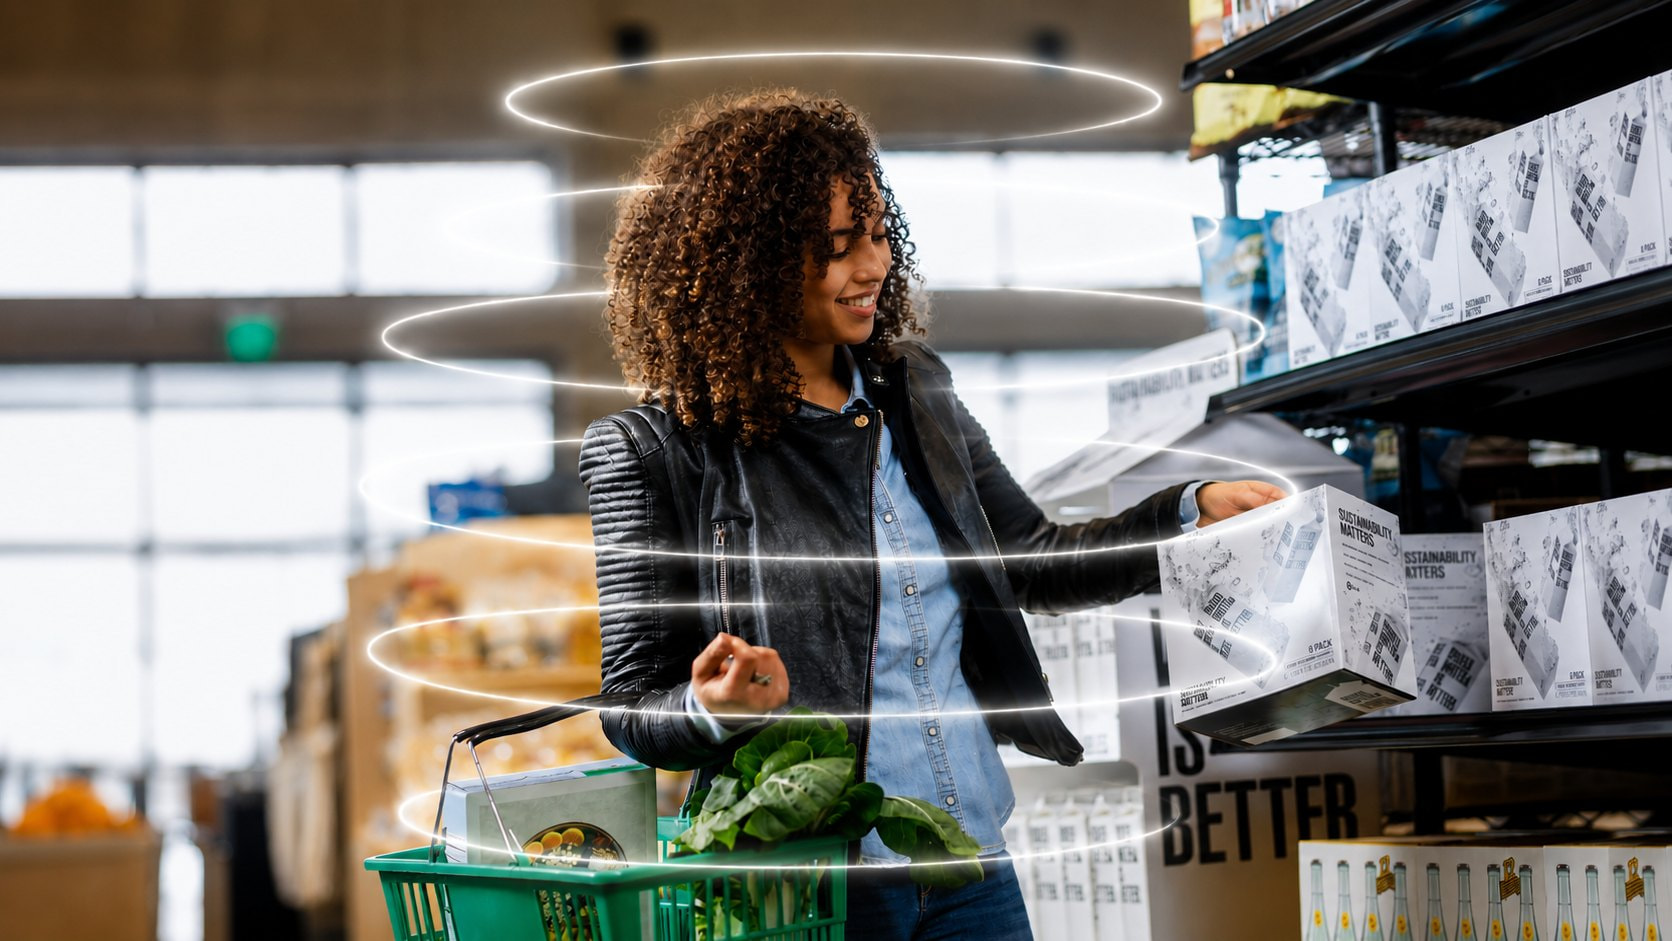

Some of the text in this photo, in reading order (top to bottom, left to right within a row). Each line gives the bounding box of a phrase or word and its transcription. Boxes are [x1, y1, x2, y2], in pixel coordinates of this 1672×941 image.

[1338, 507, 1393, 541] SUSTAINABILITY
[1340, 521, 1375, 548] MATTERS
[1314, 638, 1333, 652] PACK
[1159, 772, 1359, 867] BETTER
